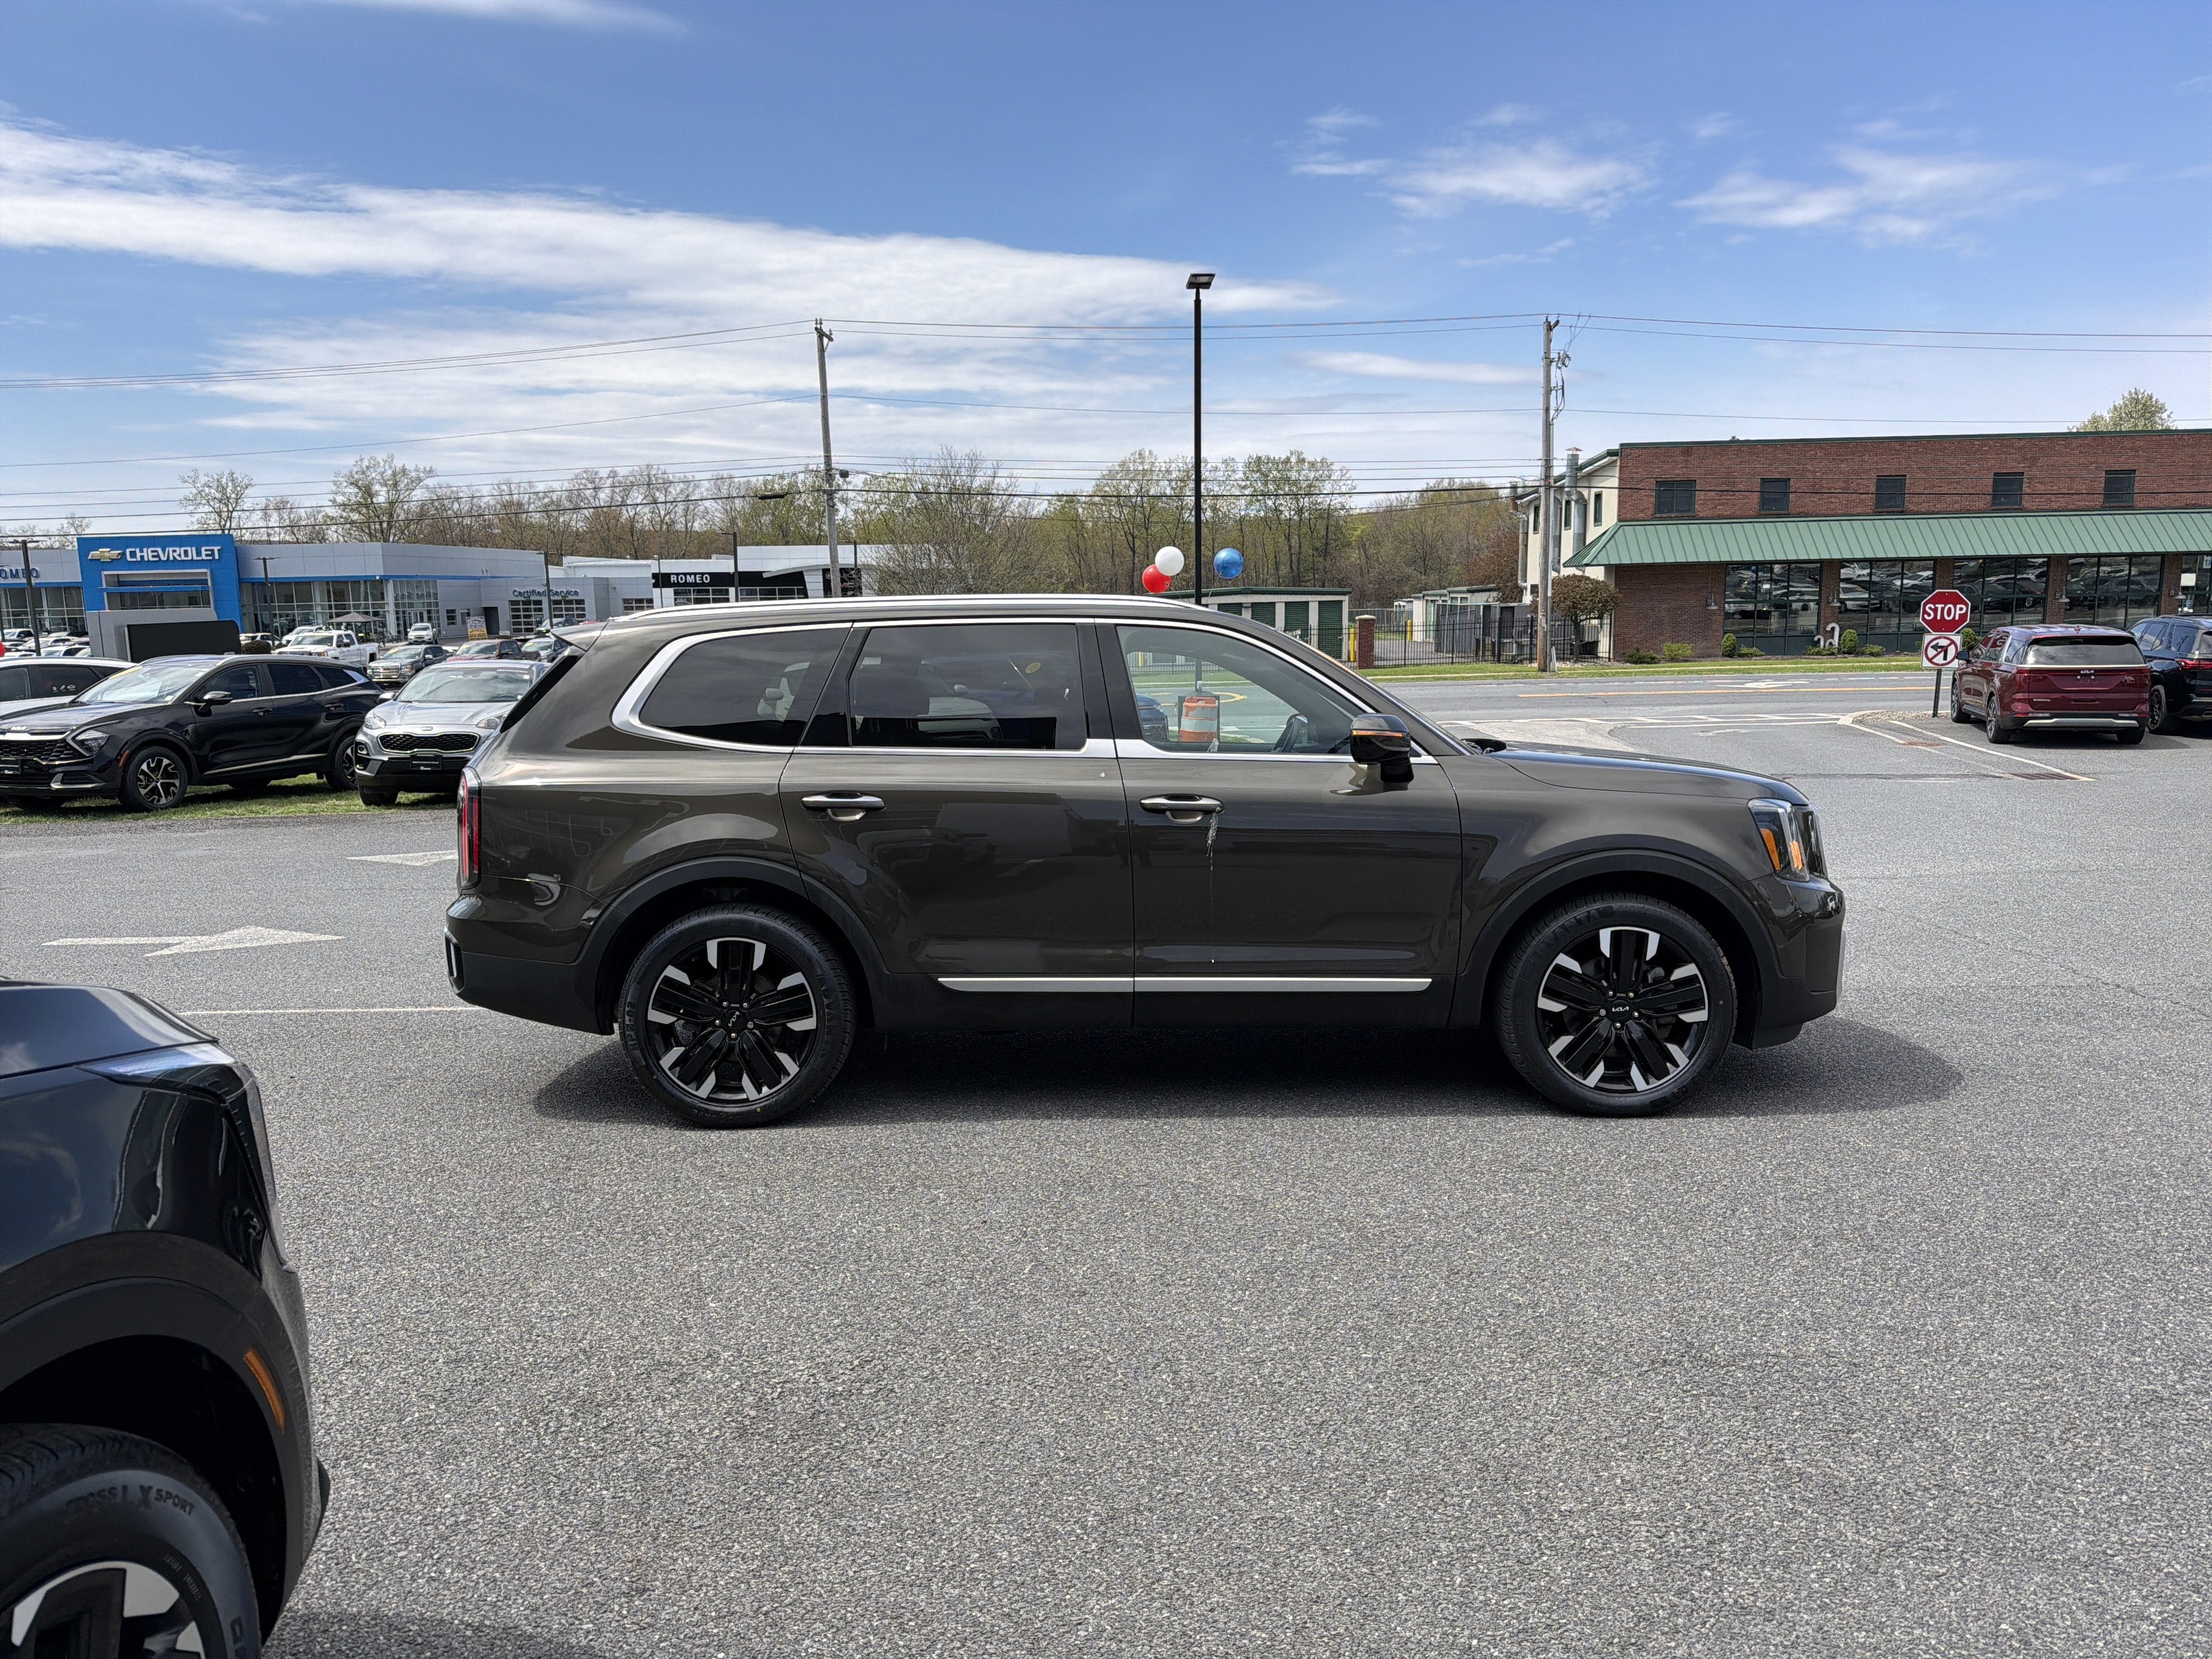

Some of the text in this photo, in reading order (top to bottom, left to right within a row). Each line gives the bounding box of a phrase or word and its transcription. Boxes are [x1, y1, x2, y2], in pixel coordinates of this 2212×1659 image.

[126, 546, 222, 561] CHEVROLET
[670, 574, 710, 583] ROMEO
[512, 589, 546, 597] Certified
[1924, 603, 1966, 620] STOP
[154, 1488, 196, 1516] SPORT
